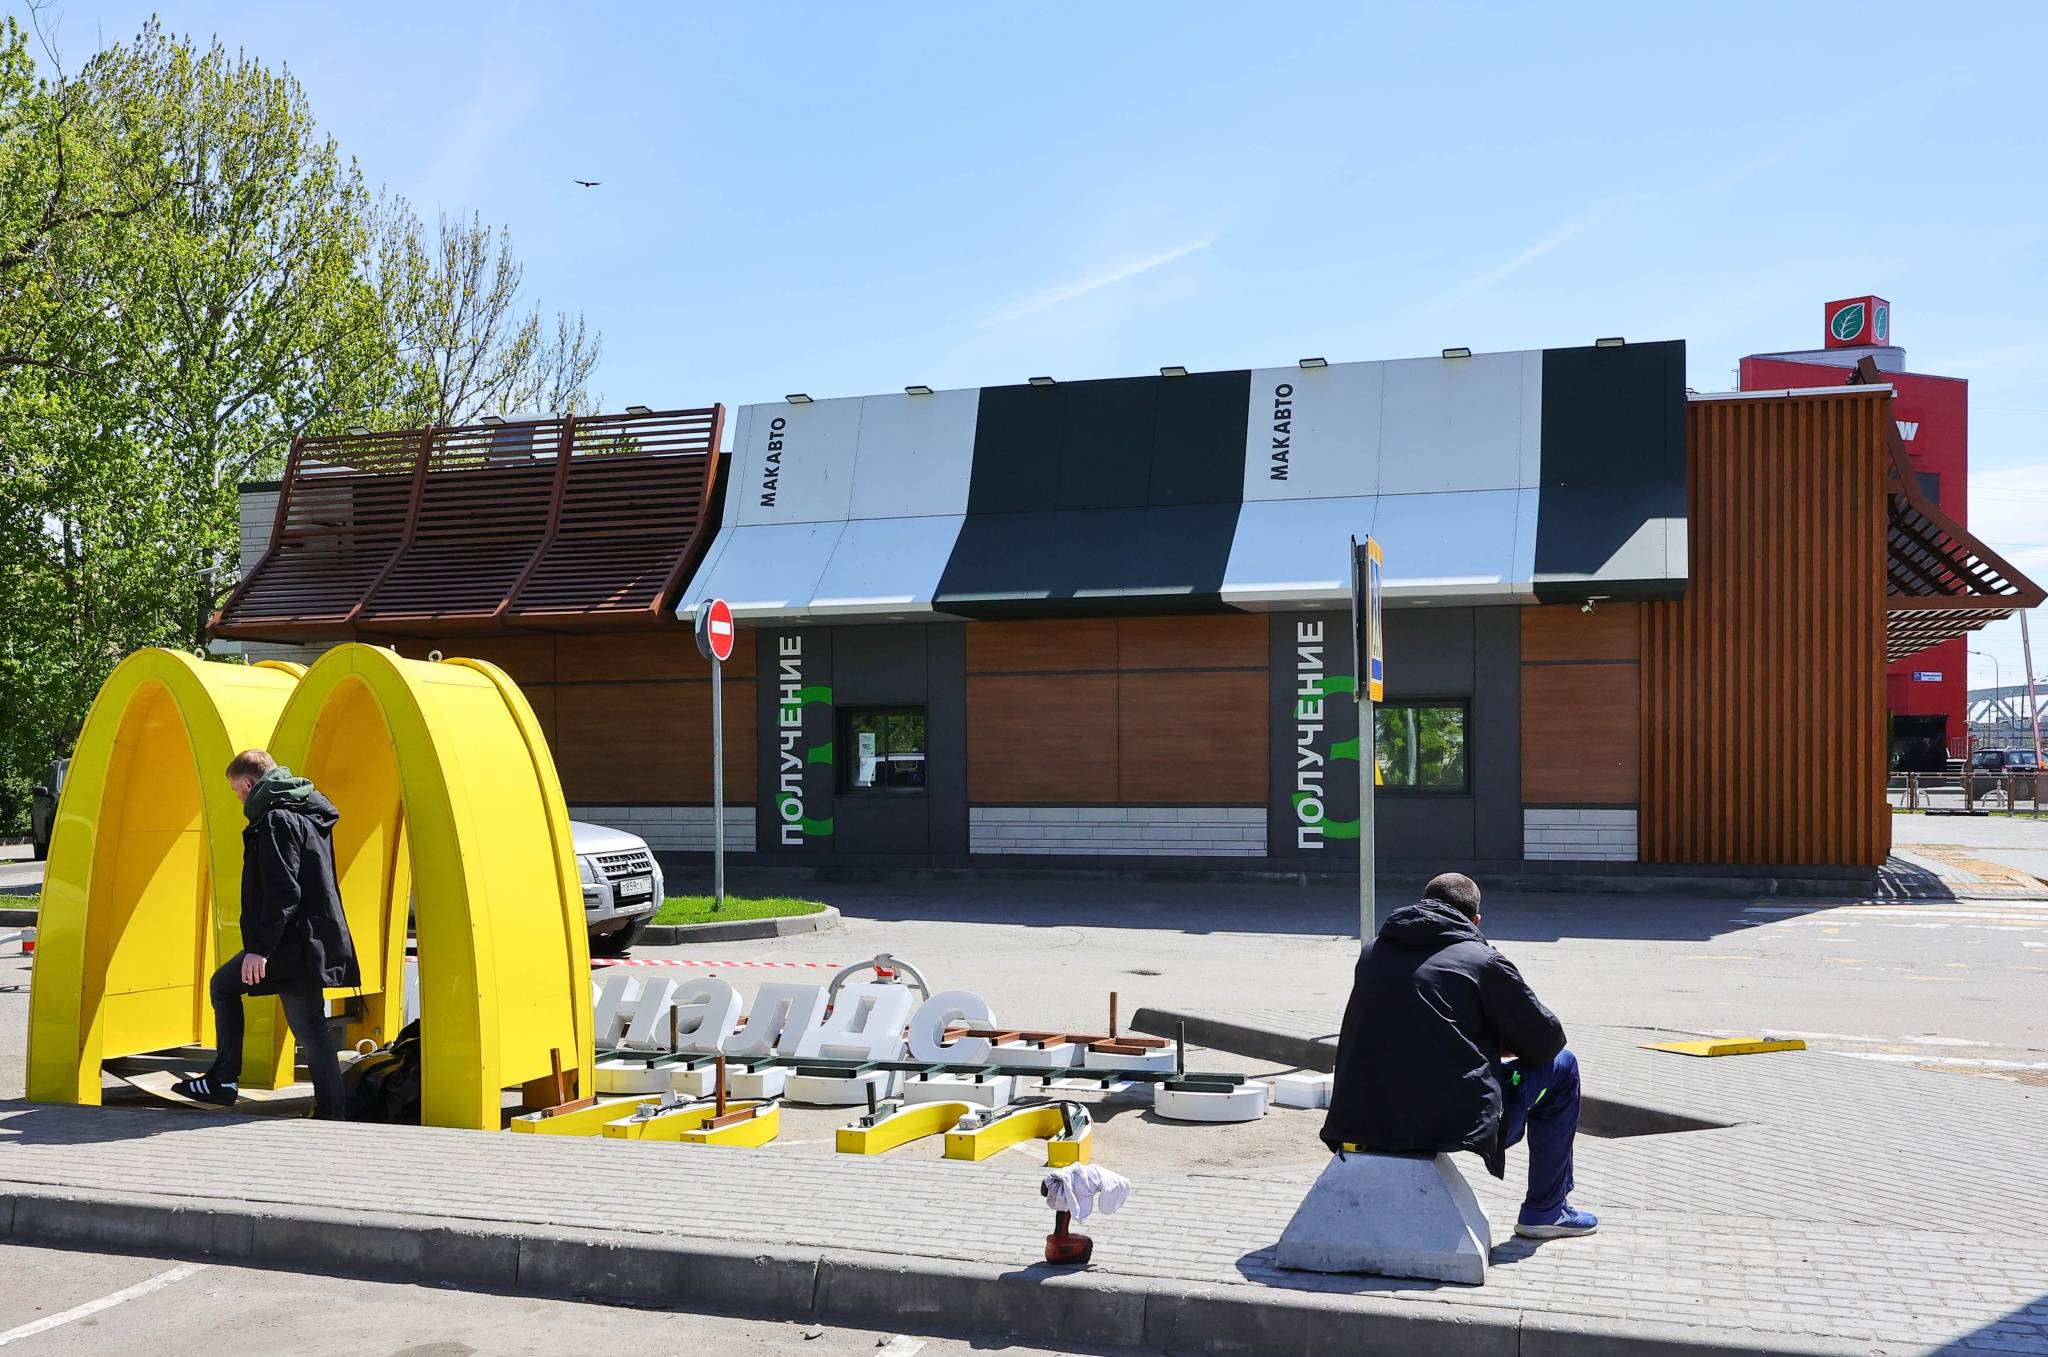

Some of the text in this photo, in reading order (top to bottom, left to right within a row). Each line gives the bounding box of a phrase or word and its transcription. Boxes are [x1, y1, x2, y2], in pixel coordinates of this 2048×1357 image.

[760, 417, 787, 508] МАКАВТО
[1270, 383, 1294, 481] МАКАВТО
[779, 635, 804, 845] ПОЛУЧЕНИЕ
[1297, 620, 1325, 849] ПОЛУЧЕНИЕ
